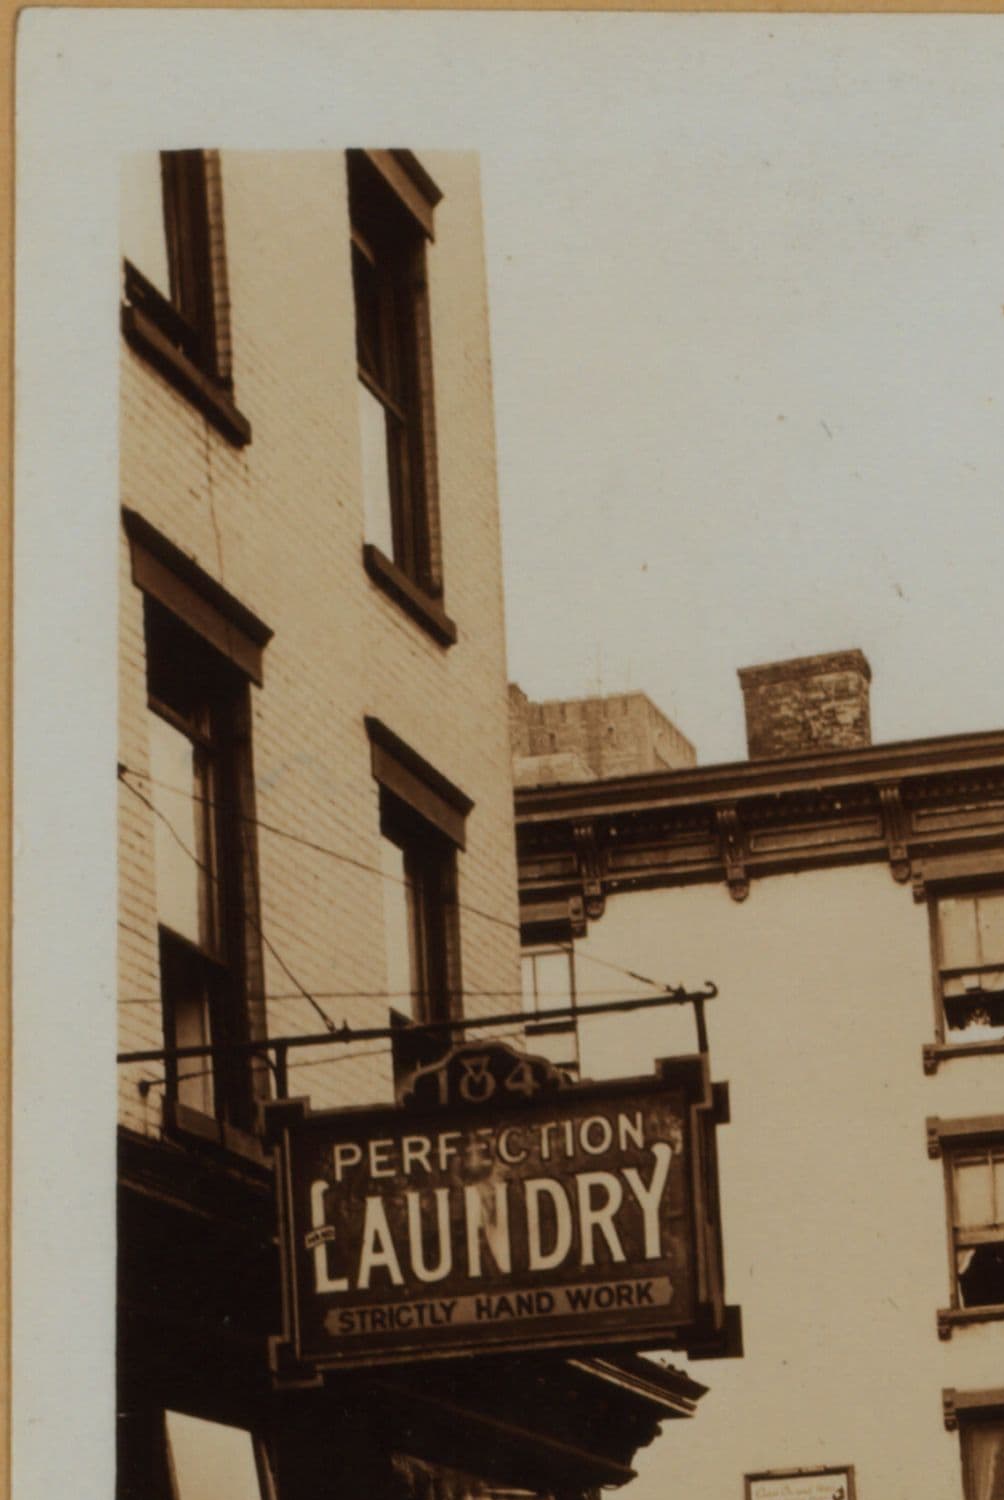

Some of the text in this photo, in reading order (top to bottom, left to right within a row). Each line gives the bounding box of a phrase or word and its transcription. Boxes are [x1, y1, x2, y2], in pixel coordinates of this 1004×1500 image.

[333, 1111, 645, 1182] PERFECTION
[310, 1142, 673, 1294] LAUNDRY
[338, 1281, 654, 1333] STRICTLY HAND WORK
